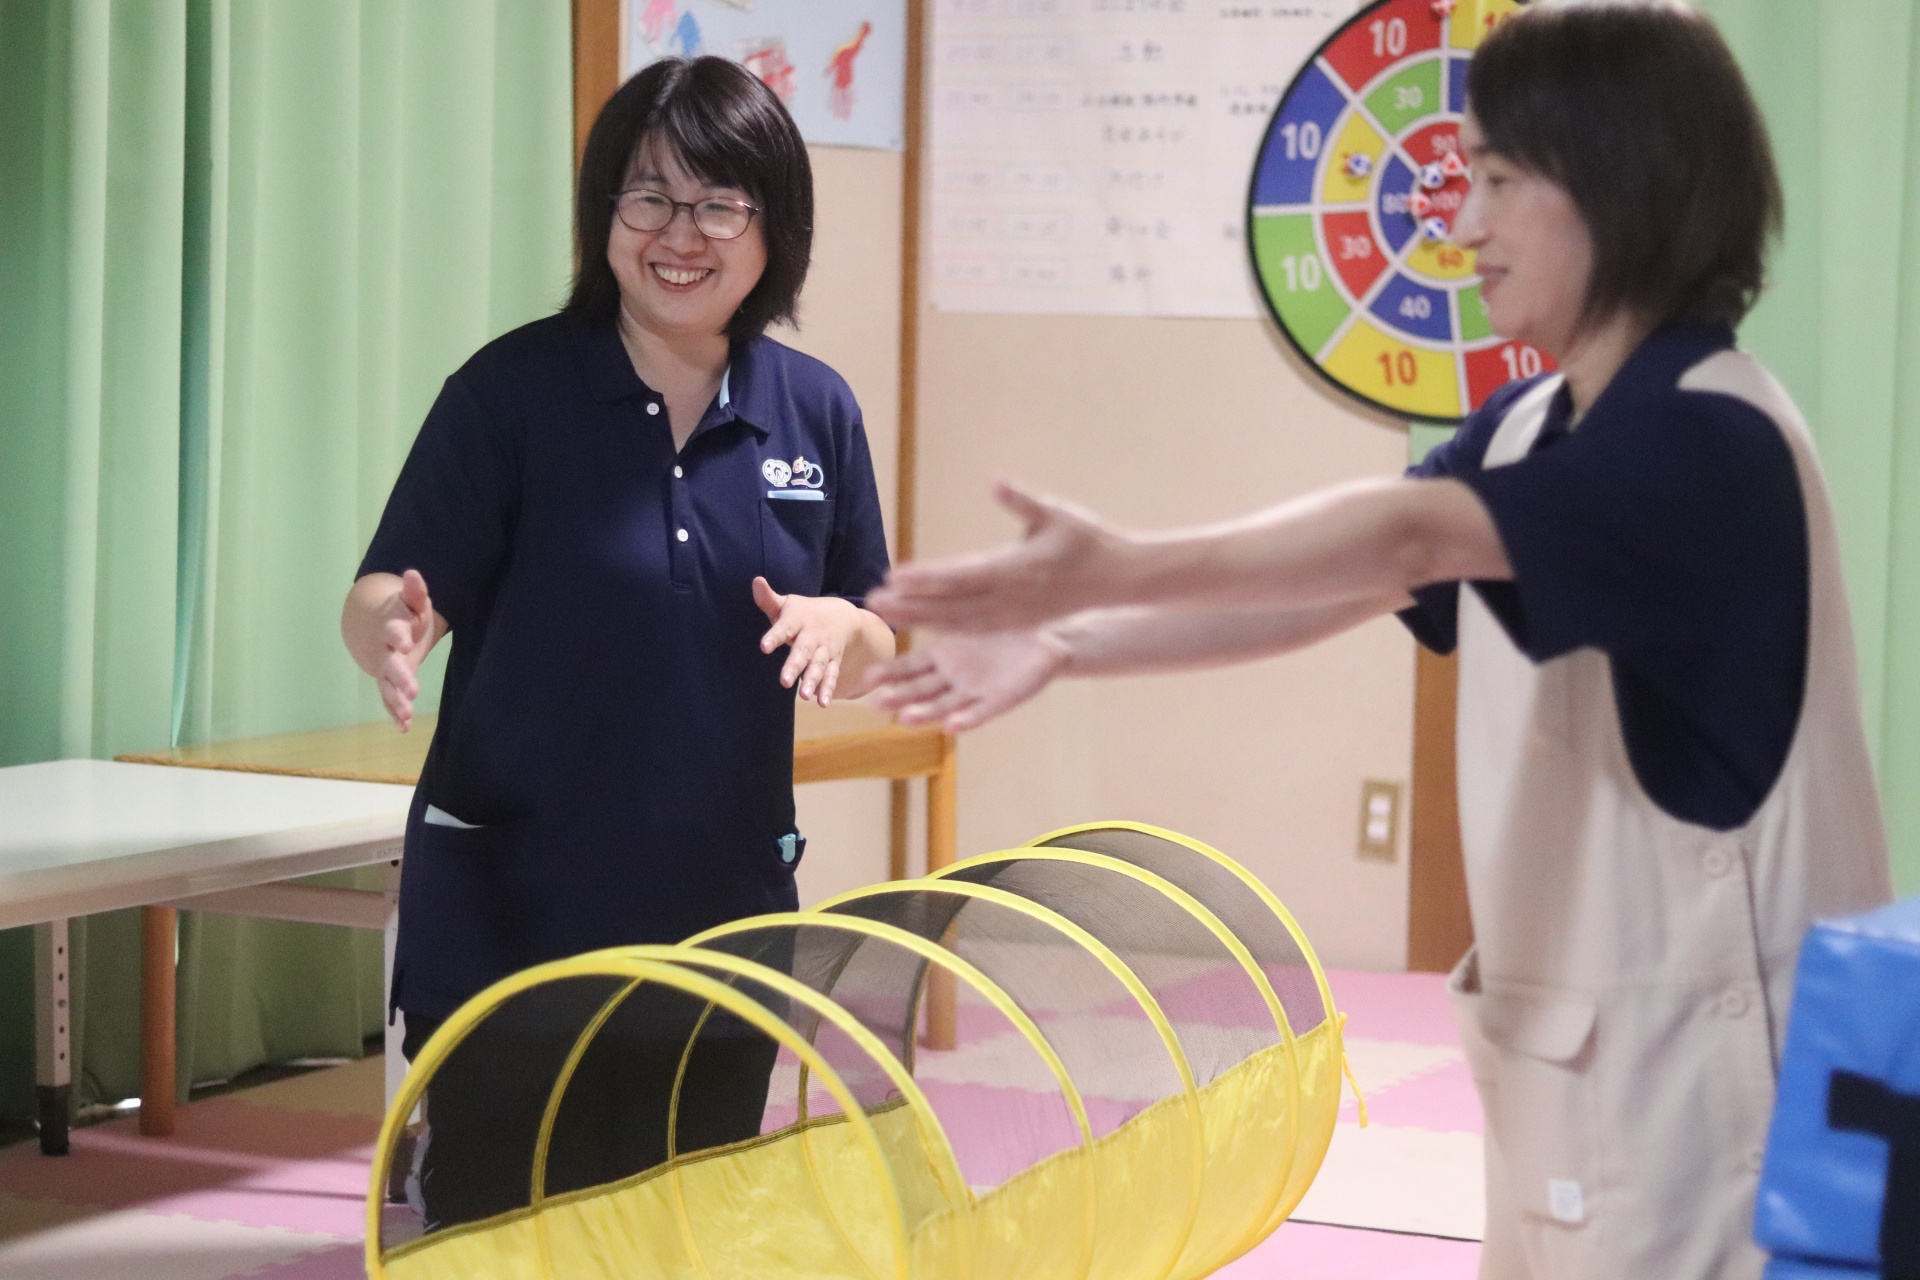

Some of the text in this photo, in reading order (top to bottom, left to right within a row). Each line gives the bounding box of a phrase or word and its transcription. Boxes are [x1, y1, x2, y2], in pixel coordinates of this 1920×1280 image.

[1370, 18, 1407, 56] 10
[1394, 86, 1422, 110] 30
[1281, 121, 1322, 161] 10
[1340, 234, 1371, 260] 30
[1436, 247, 1463, 270] 60
[1281, 254, 1322, 293] 10
[1400, 295, 1431, 319] 40
[1377, 350, 1417, 387] 10
[1501, 344, 1542, 380] 10
